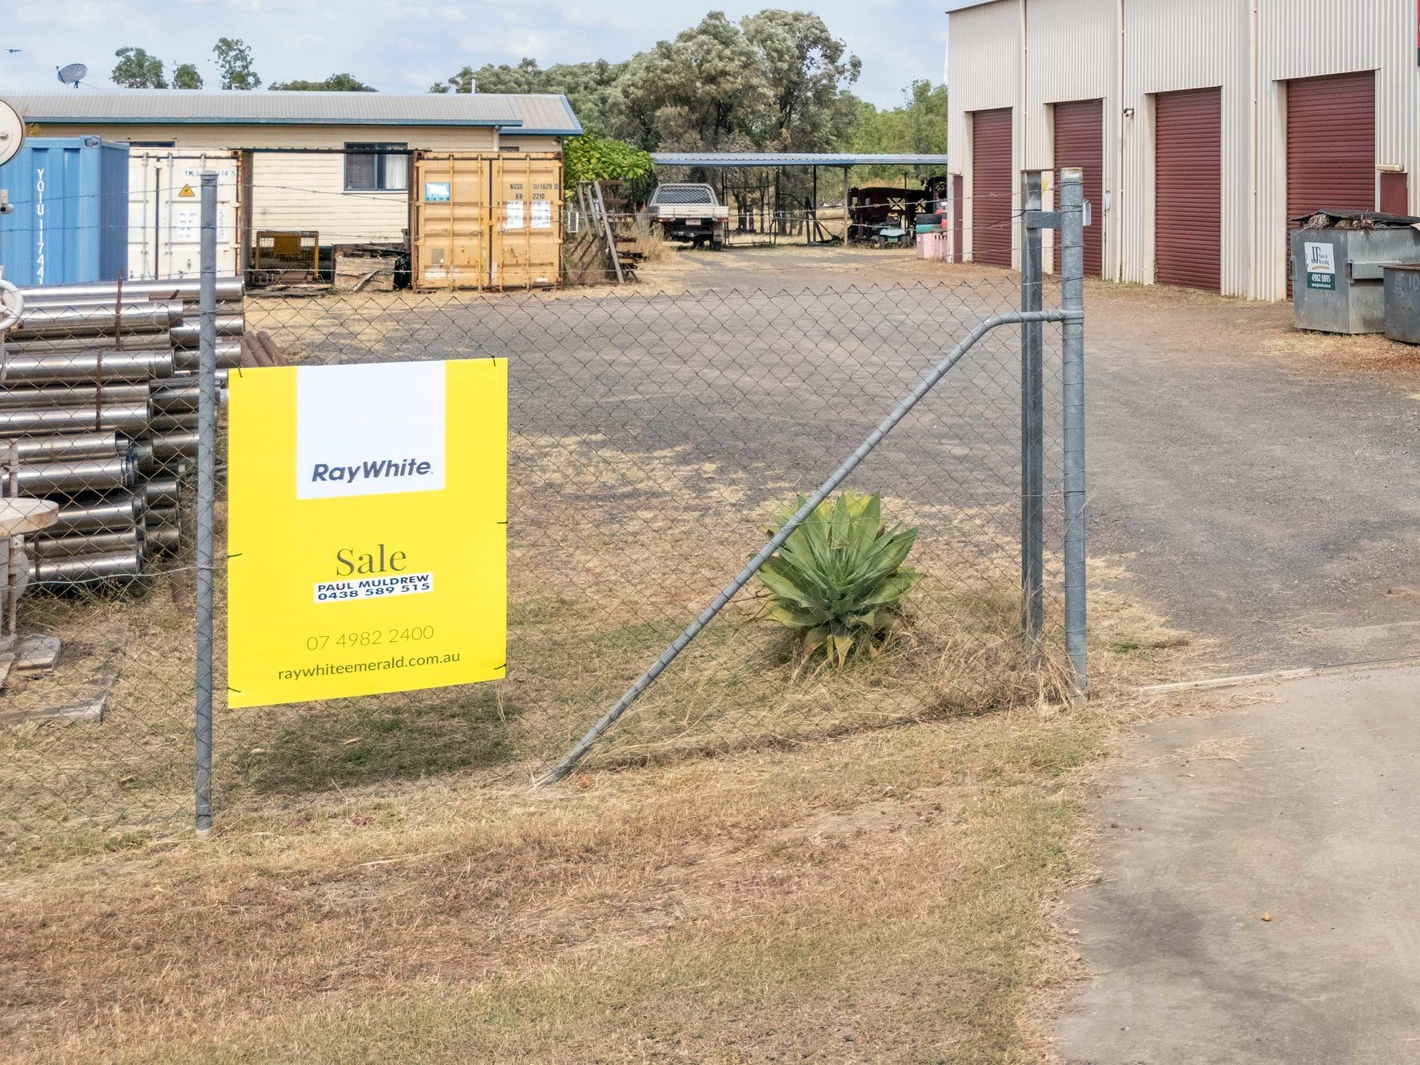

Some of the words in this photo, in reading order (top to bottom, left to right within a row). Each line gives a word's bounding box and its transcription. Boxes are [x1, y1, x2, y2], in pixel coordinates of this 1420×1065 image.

[336, 544, 407, 577] Sale
[317, 590, 359, 602] 0438
[364, 586, 395, 597] 589
[400, 582, 431, 594] 515
[318, 581, 354, 593] PAUL
[358, 574, 430, 590] MULDREW
[306, 635, 330, 651] 07
[336, 629, 382, 649] 4982
[388, 625, 434, 644] 2400
[278, 652, 460, 681] raywhiteemerald.com.au
